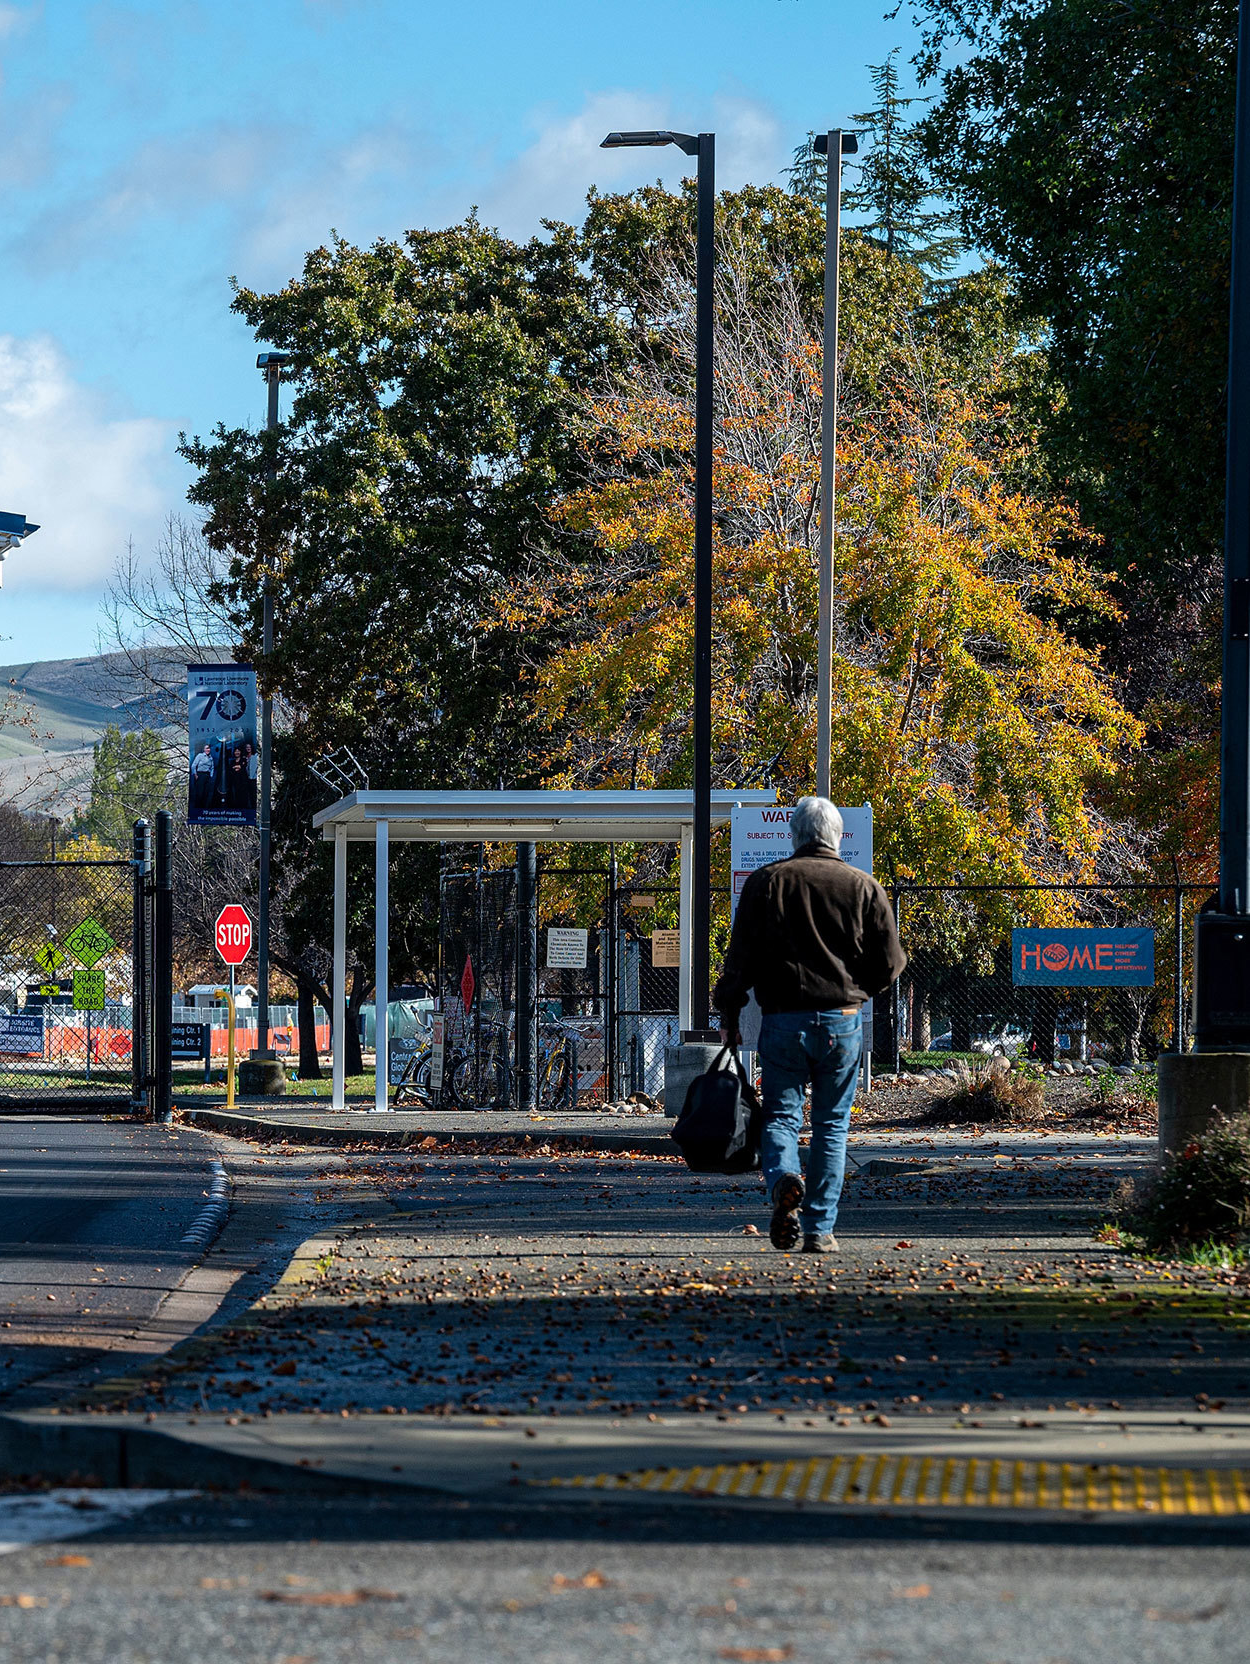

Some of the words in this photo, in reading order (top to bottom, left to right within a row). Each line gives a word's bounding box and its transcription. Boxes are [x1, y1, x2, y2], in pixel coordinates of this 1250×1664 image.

[196, 690, 246, 720] 70
[747, 832, 774, 840] SUBJECT
[777, 832, 786, 840] TO
[218, 924, 250, 946] STOP
[1021, 943, 1113, 971] HOME
[77, 975, 101, 983] SHARE
[82, 986, 96, 994] THE
[78, 997, 99, 1005] ROAD
[186, 1026, 196, 1034] Ctr.
[197, 1026, 201, 1034] 1
[186, 1037, 196, 1045] Ctr.
[197, 1037, 201, 1045] 2
